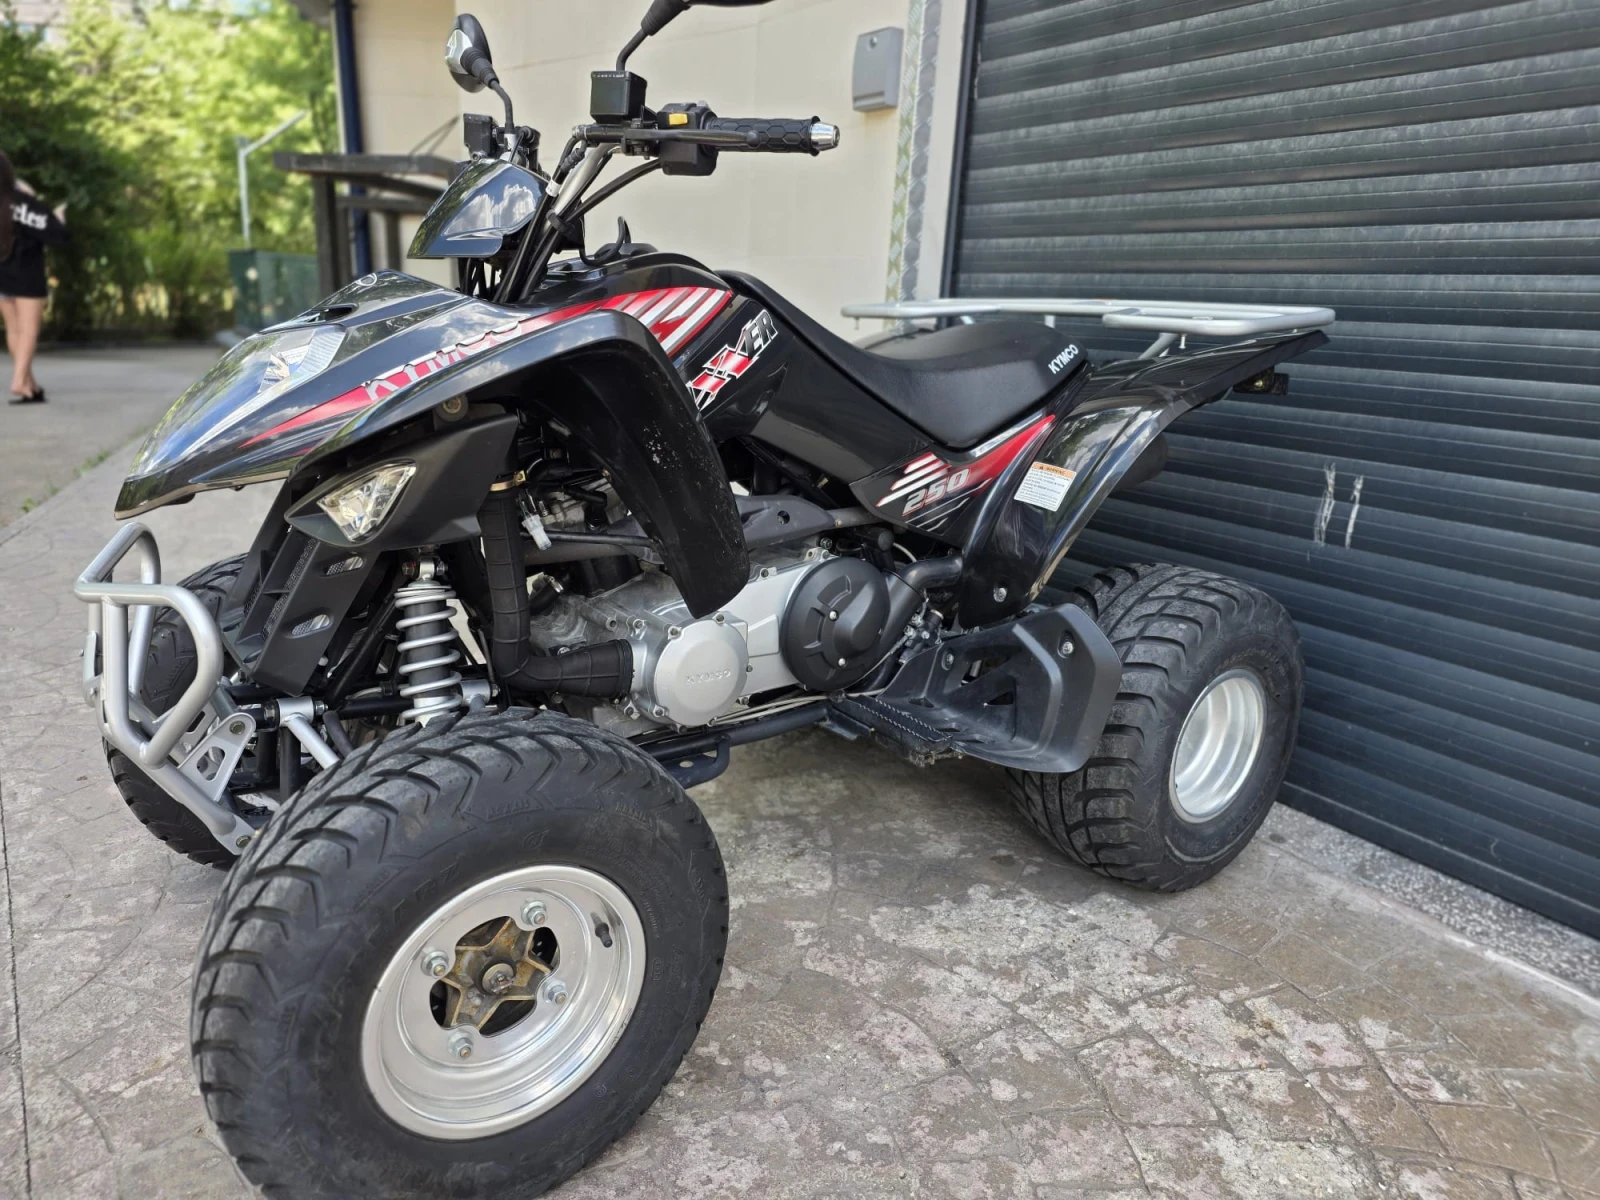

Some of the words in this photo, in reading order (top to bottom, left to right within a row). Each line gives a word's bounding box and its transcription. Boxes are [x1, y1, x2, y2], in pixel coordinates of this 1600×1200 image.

[1048, 344, 1079, 374] KYMCO
[902, 468, 970, 516] 250
[686, 668, 731, 684] KYMCO
